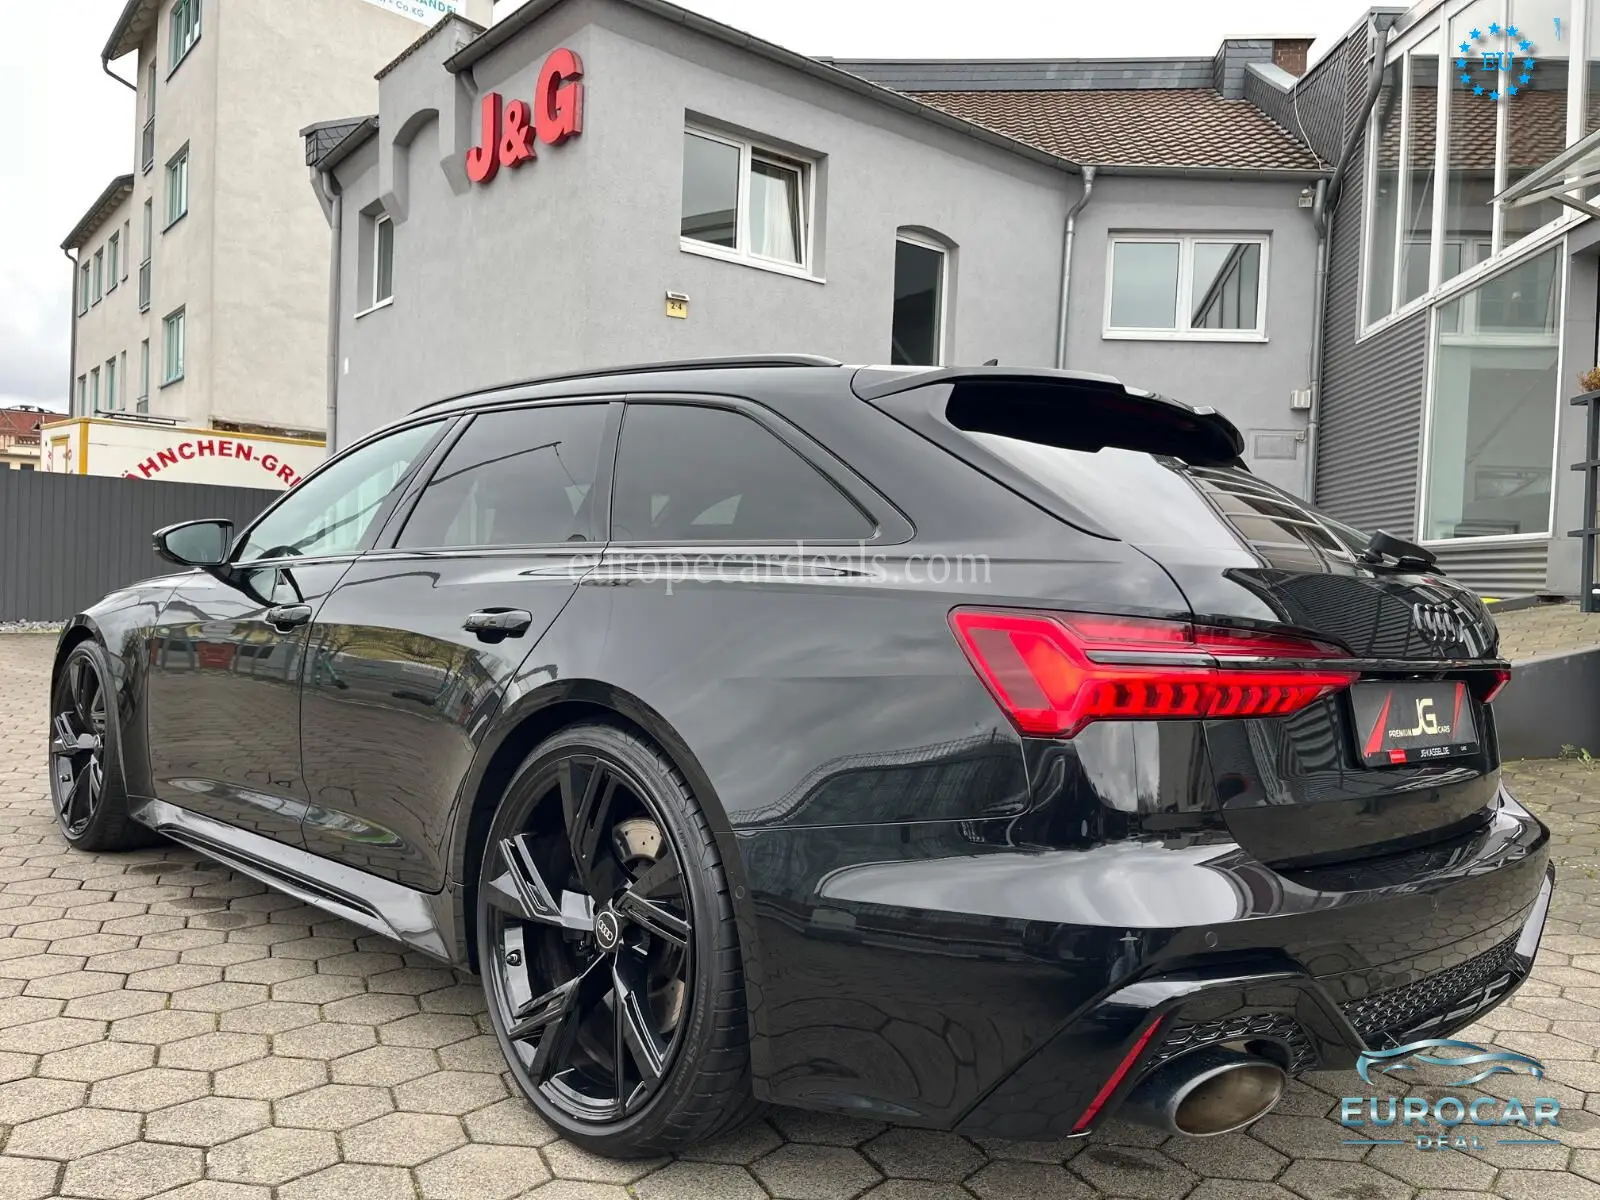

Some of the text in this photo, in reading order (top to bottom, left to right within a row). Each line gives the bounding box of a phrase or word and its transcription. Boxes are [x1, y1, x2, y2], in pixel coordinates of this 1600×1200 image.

[465, 47, 584, 184] J&G
[122, 440, 301, 487] HNCHEN-GRI
[1388, 698, 1451, 738] PREMIUM JG CARS
